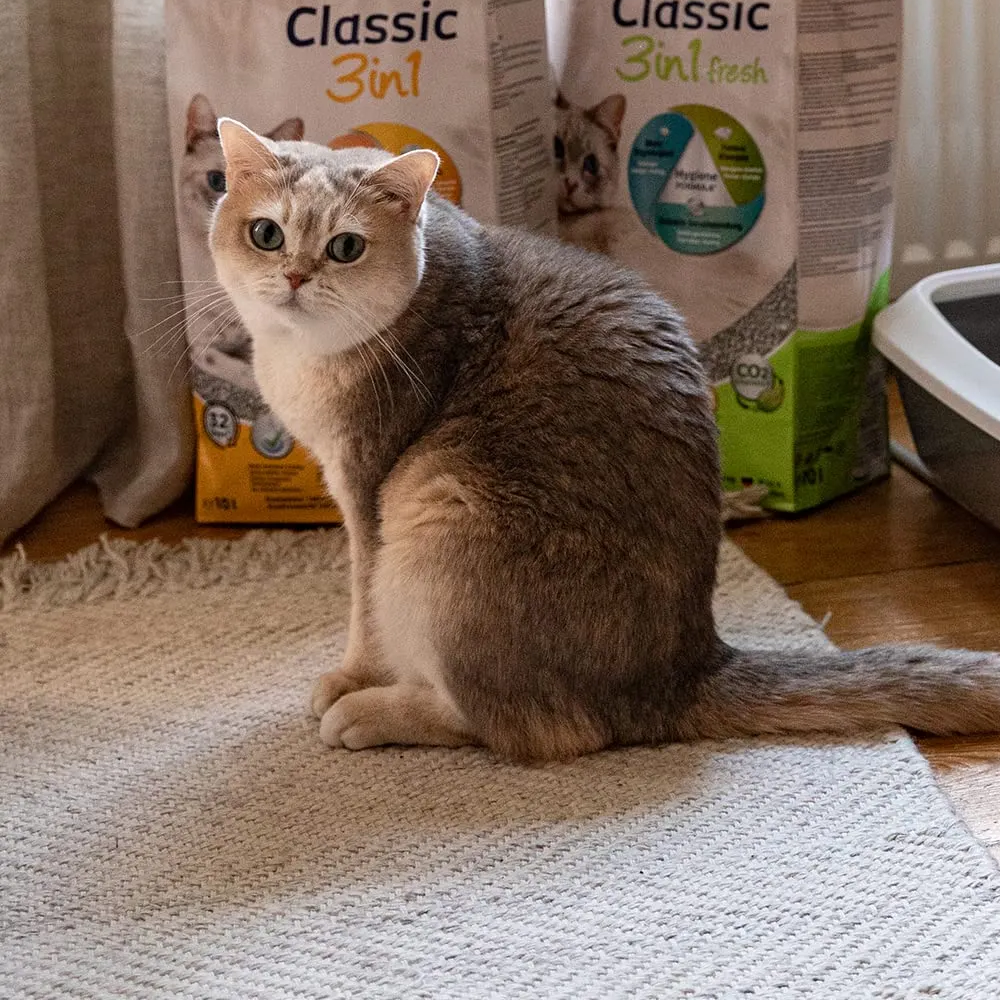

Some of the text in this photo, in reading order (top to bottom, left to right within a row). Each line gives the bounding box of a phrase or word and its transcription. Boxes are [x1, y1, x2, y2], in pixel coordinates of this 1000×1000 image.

[286, 0, 459, 47] Classic
[326, 50, 422, 103] 3in1
[615, 35, 769, 84] 3in1 fresh
